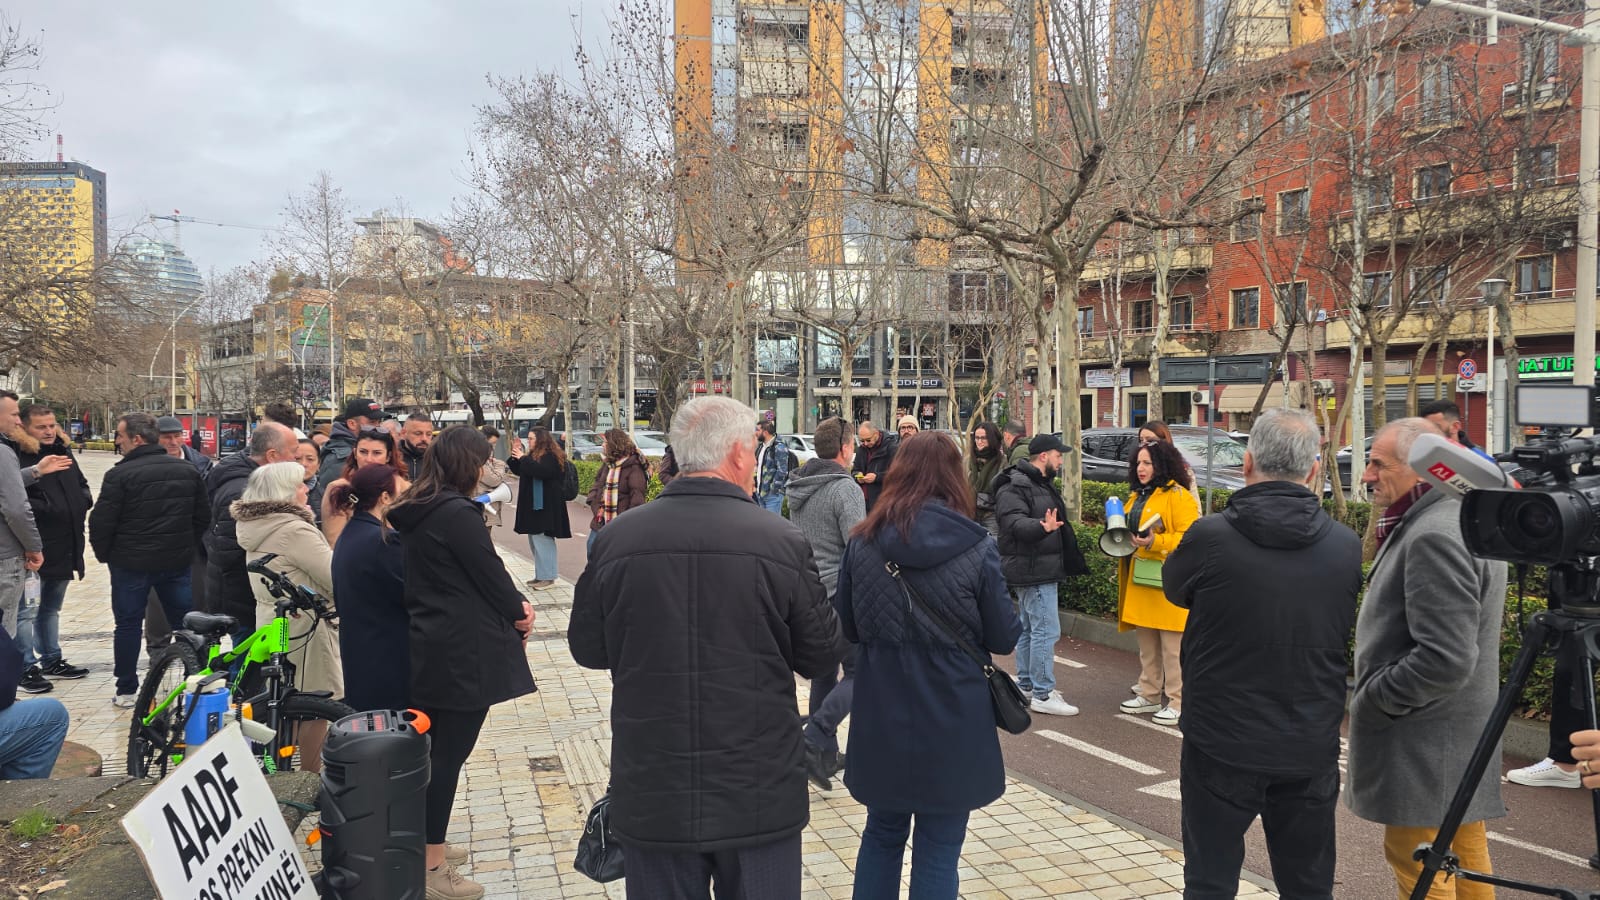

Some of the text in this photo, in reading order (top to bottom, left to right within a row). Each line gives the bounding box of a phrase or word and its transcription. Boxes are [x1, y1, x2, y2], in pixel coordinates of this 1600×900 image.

[1432, 467, 1450, 479] TV
[162, 751, 243, 883] AADF
[217, 817, 275, 900] PREKNI
